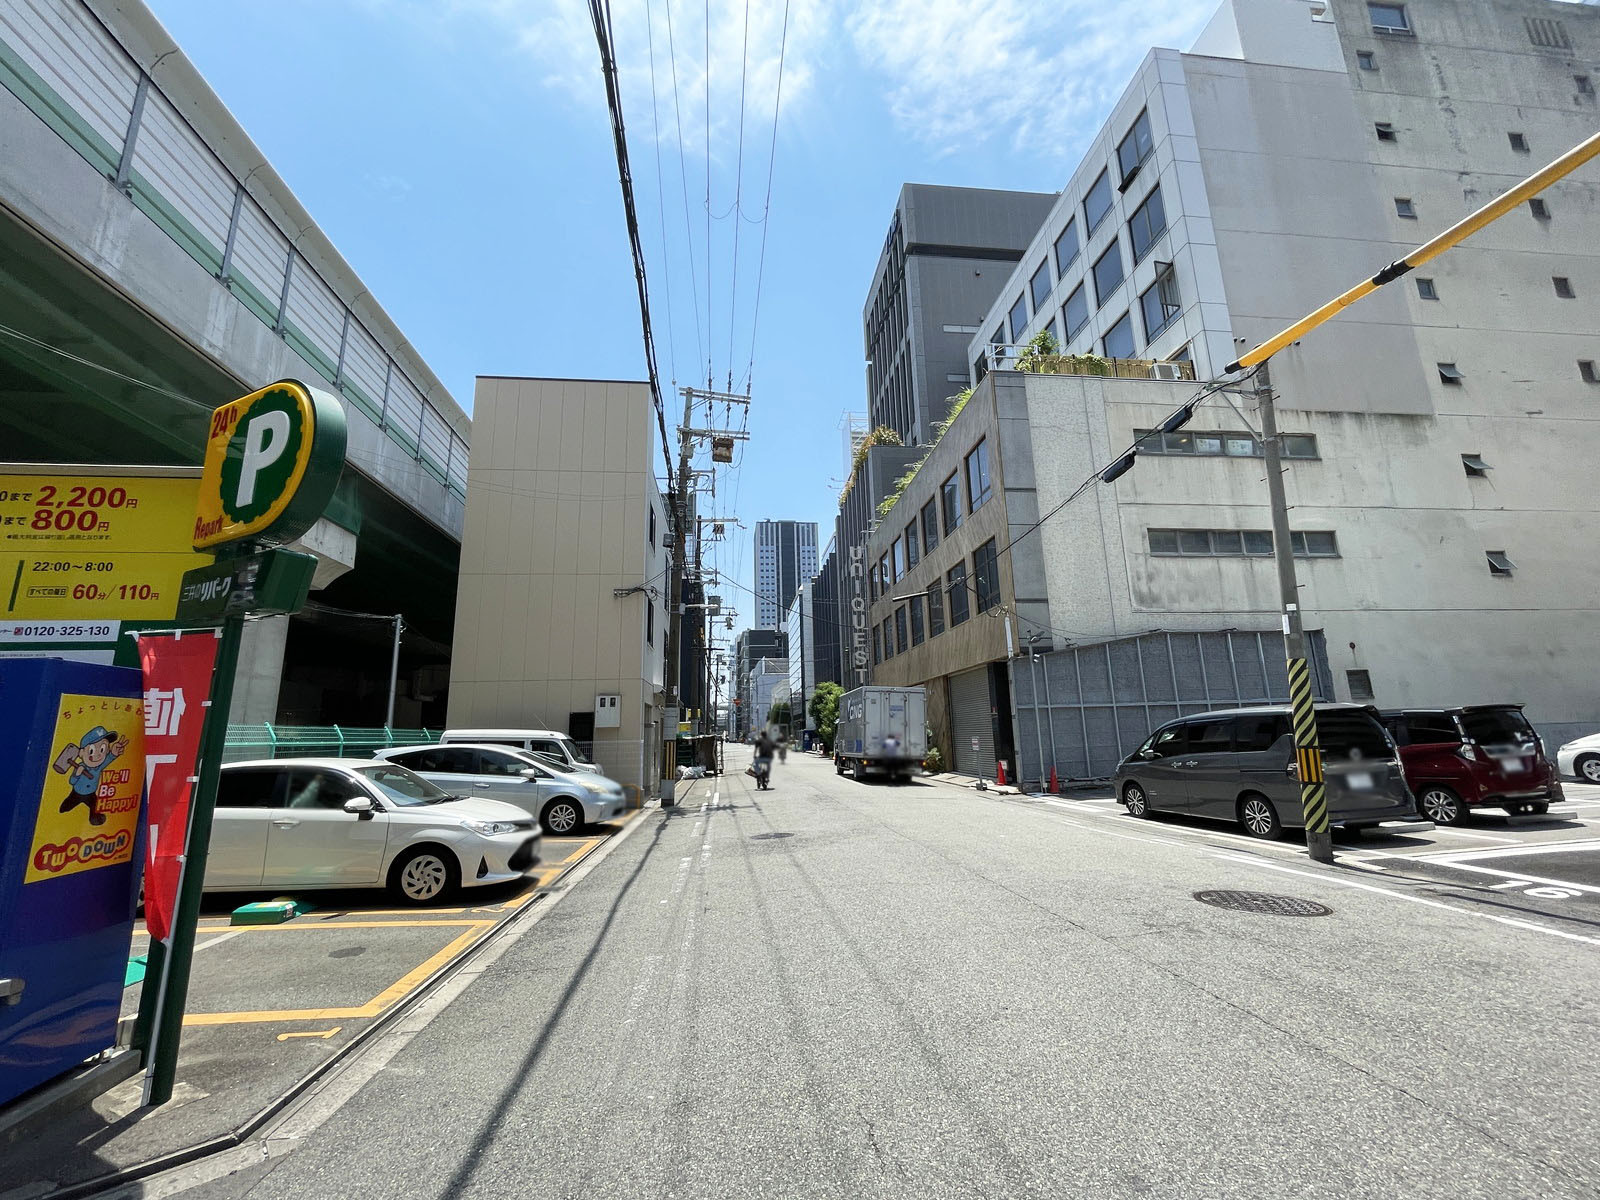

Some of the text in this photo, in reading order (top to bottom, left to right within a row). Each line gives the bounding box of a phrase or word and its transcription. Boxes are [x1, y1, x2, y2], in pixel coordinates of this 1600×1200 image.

[212, 406, 238, 439] 24h
[235, 410, 290, 508] P
[30, 508, 110, 531] 800円
[193, 514, 224, 540] Repark
[24, 626, 110, 637] 0120-325-130
[101, 770, 130, 784] We'll
[99, 784, 115, 798] Be
[97, 796, 137, 812] Happy!
[41, 843, 78, 866] TWO
[83, 834, 127, 859] DOWN
